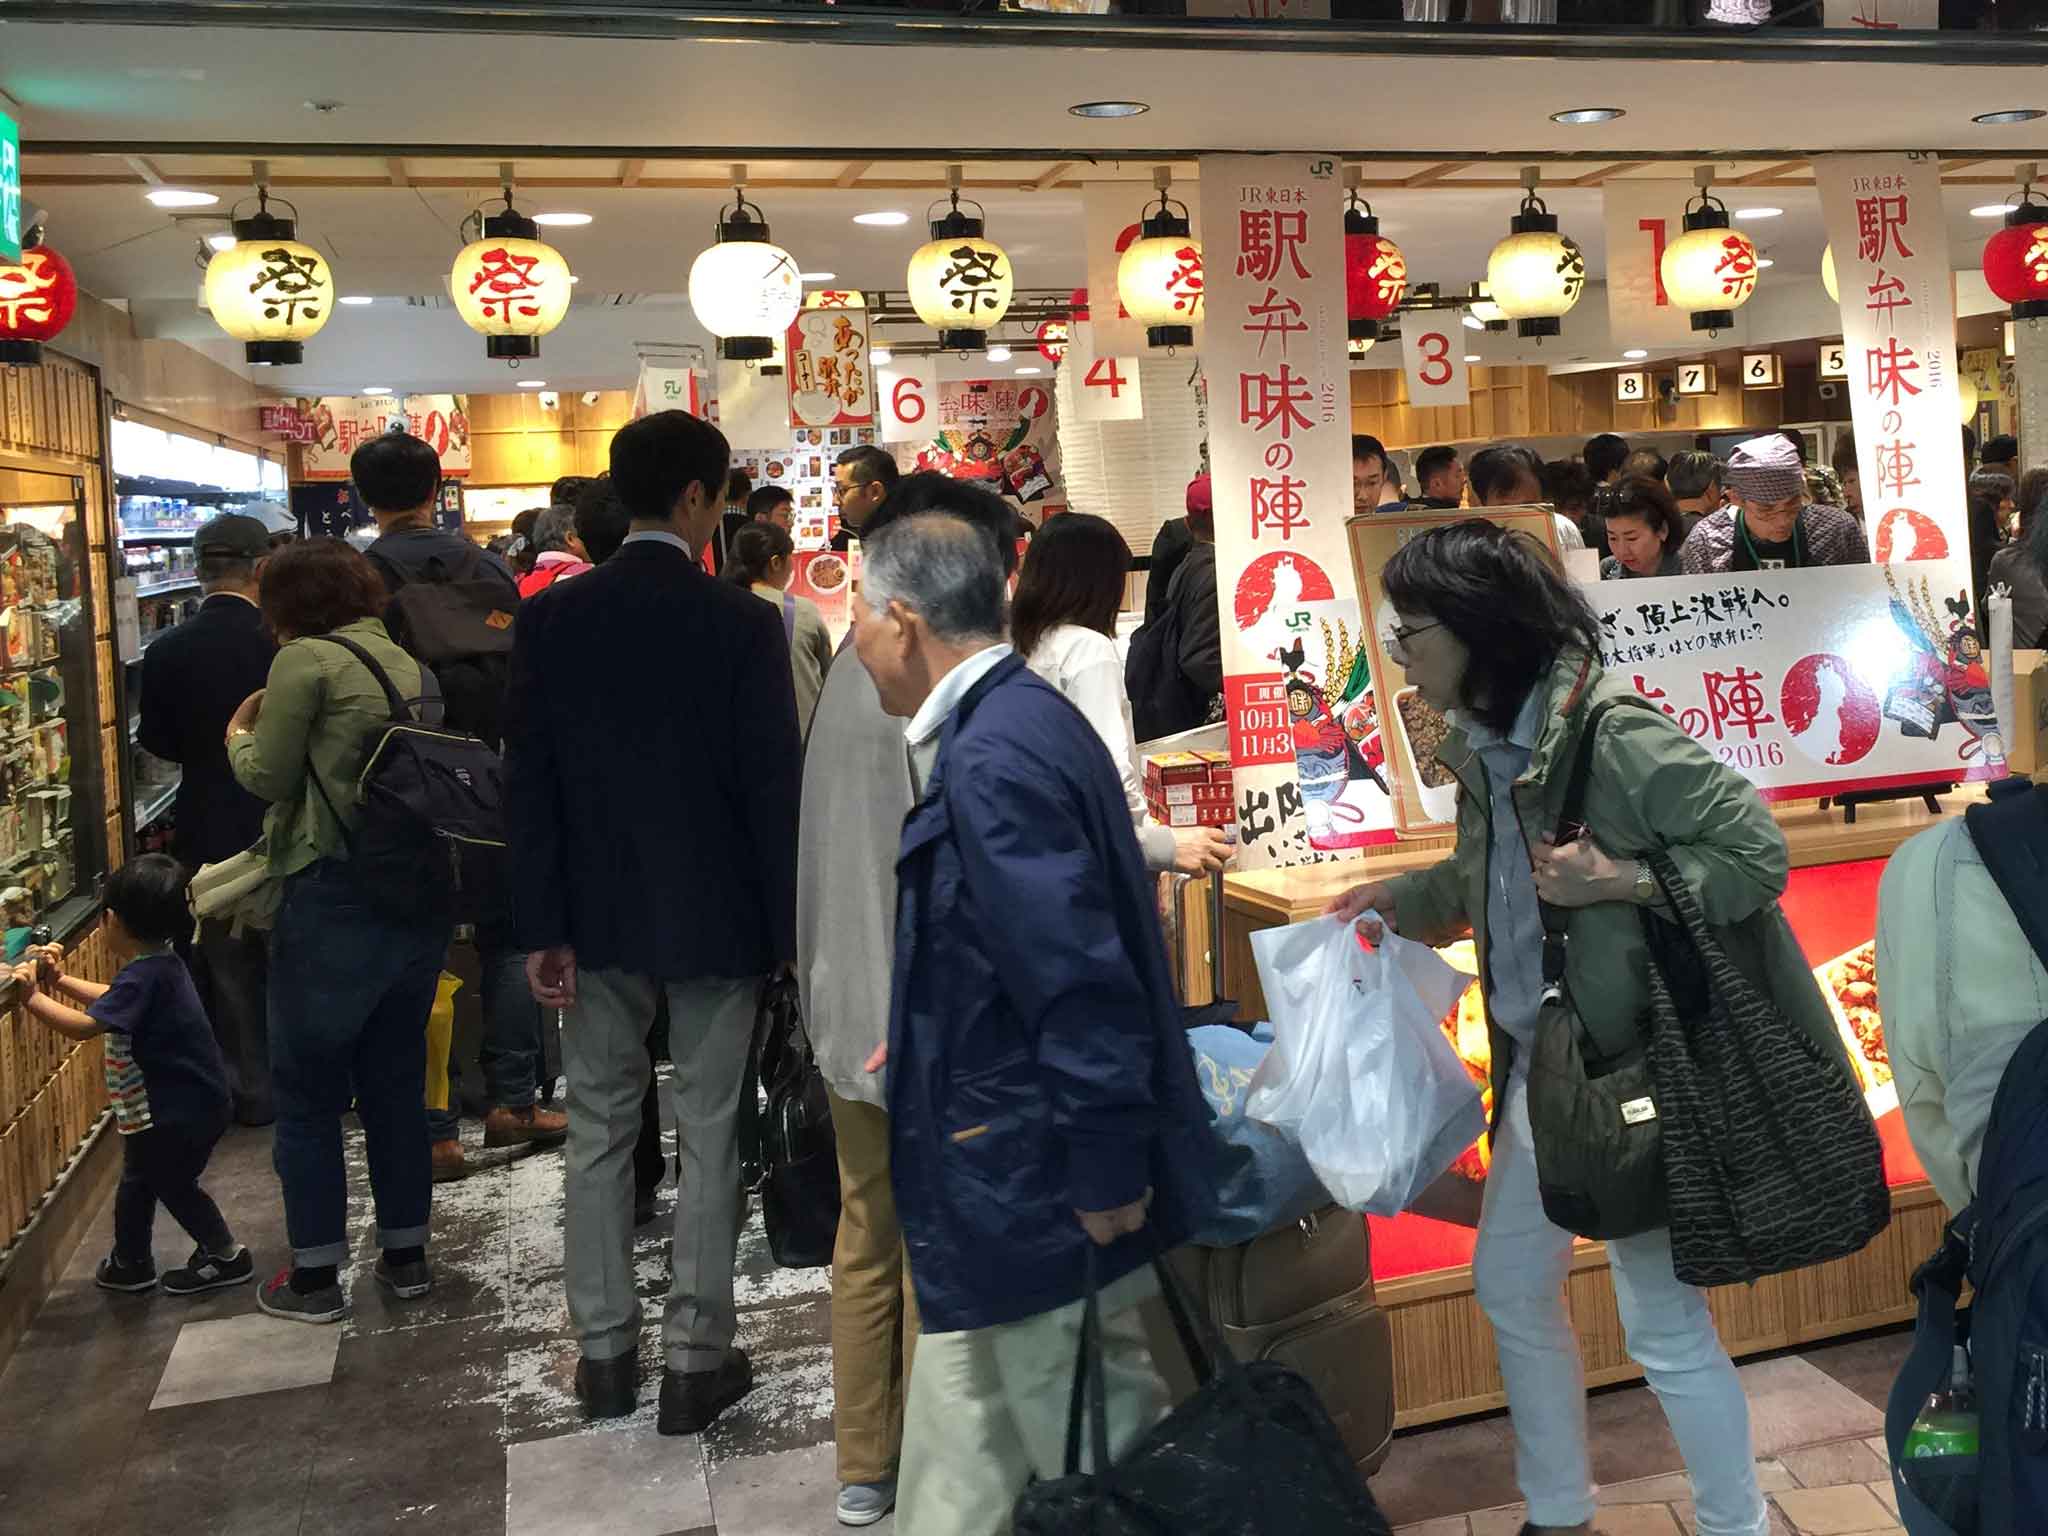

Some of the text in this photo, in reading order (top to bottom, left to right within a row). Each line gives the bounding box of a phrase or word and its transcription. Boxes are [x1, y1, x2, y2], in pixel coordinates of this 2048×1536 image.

[1310, 161, 1333, 174] JR
[1852, 175, 1907, 193] JR東日本
[1240, 186, 1308, 203] JR東日本
[249, 247, 326, 326] 祭
[470, 247, 545, 324] 祭
[940, 246, 1004, 315] 祭
[833, 315, 864, 407] あったか
[1416, 332, 1454, 386] 3
[1829, 351, 1844, 369] 5
[1855, 195, 1922, 500] 駅弁味の陣
[798, 353, 810, 390] コーナー
[1084, 357, 1127, 398] 4
[1236, 209, 1316, 541] 駅弁味の陣
[1624, 378, 1637, 394] 8
[1685, 370, 1699, 386] 7
[1750, 360, 1765, 377] 6
[892, 377, 926, 424] 6
[1321, 383, 1335, 424] 2016
[1285, 611, 1311, 627] JR
[1633, 666, 1776, 741] の陣
[1719, 741, 1784, 769] 2016
